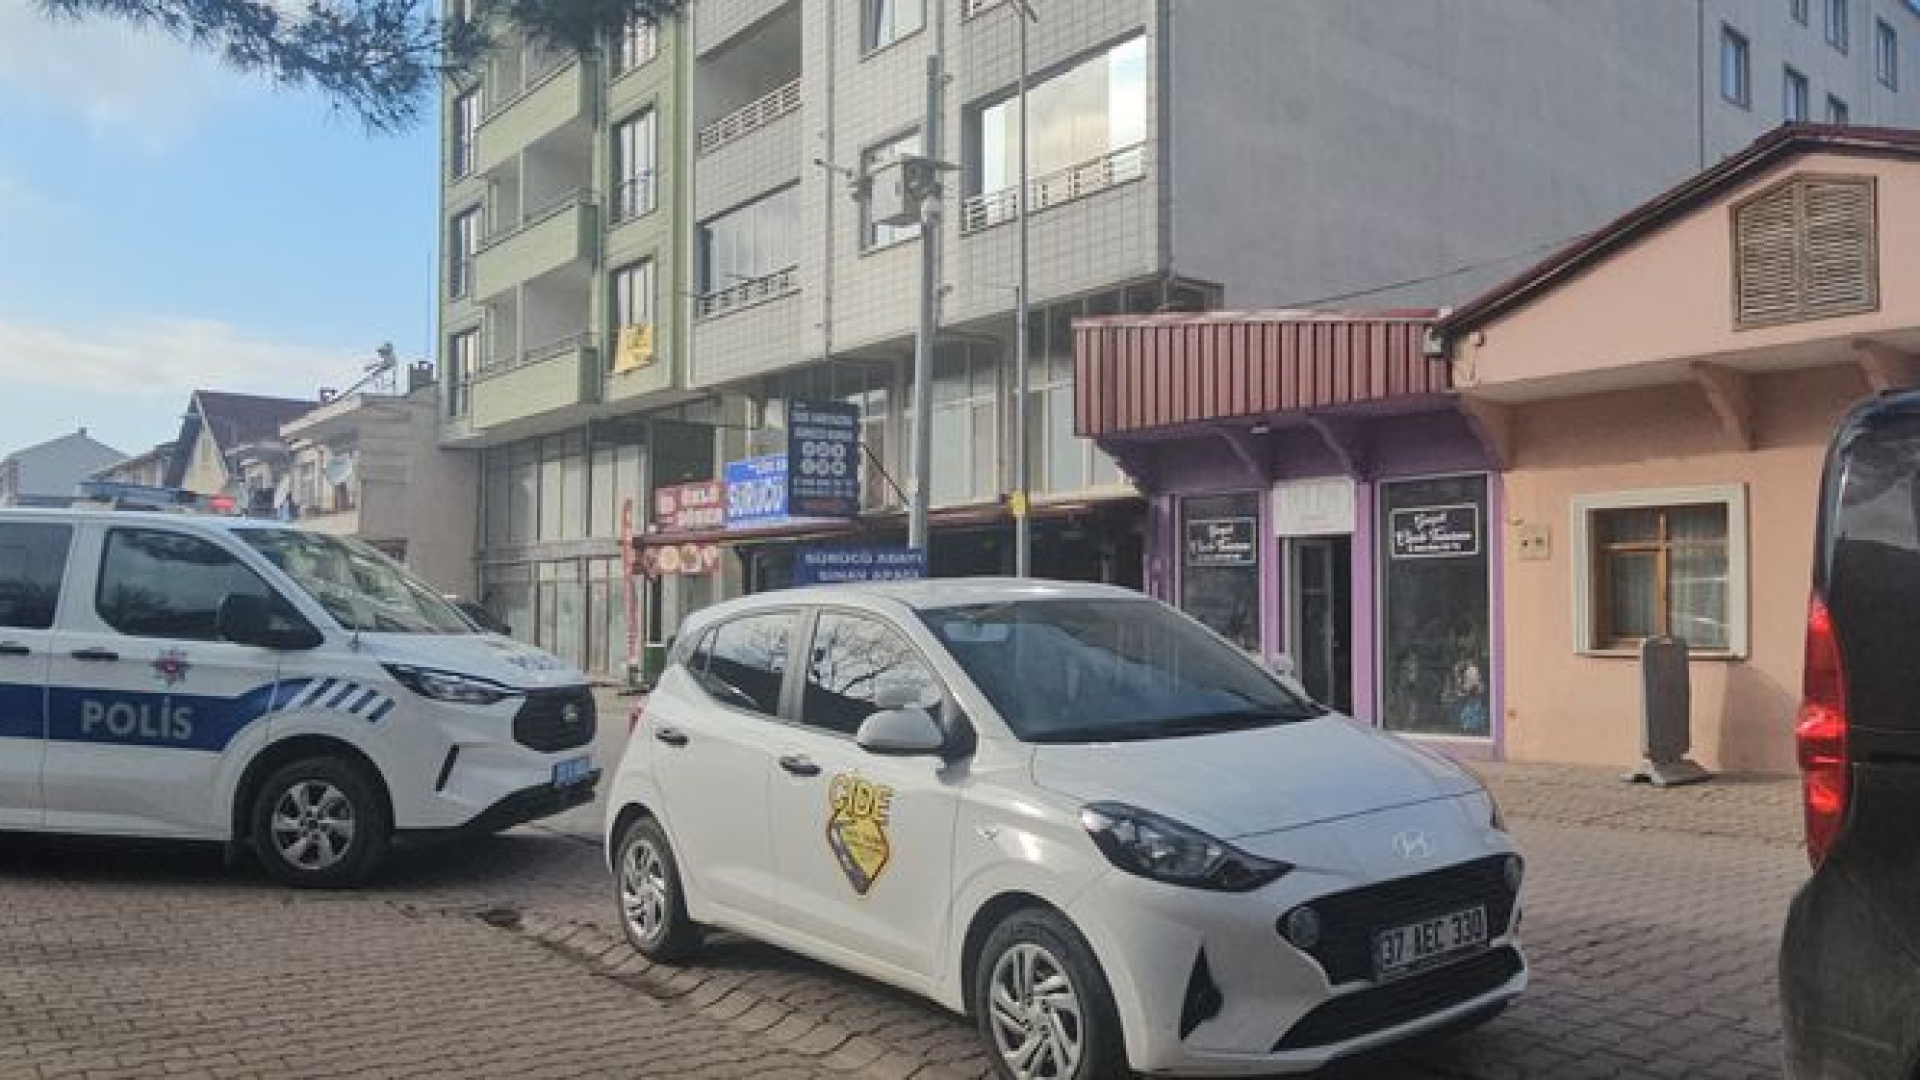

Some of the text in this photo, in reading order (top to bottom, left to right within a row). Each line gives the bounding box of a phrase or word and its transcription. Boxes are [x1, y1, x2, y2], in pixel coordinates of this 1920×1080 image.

[82, 696, 194, 740] POLİS
[1381, 908, 1483, 966] 37 AEC 330
